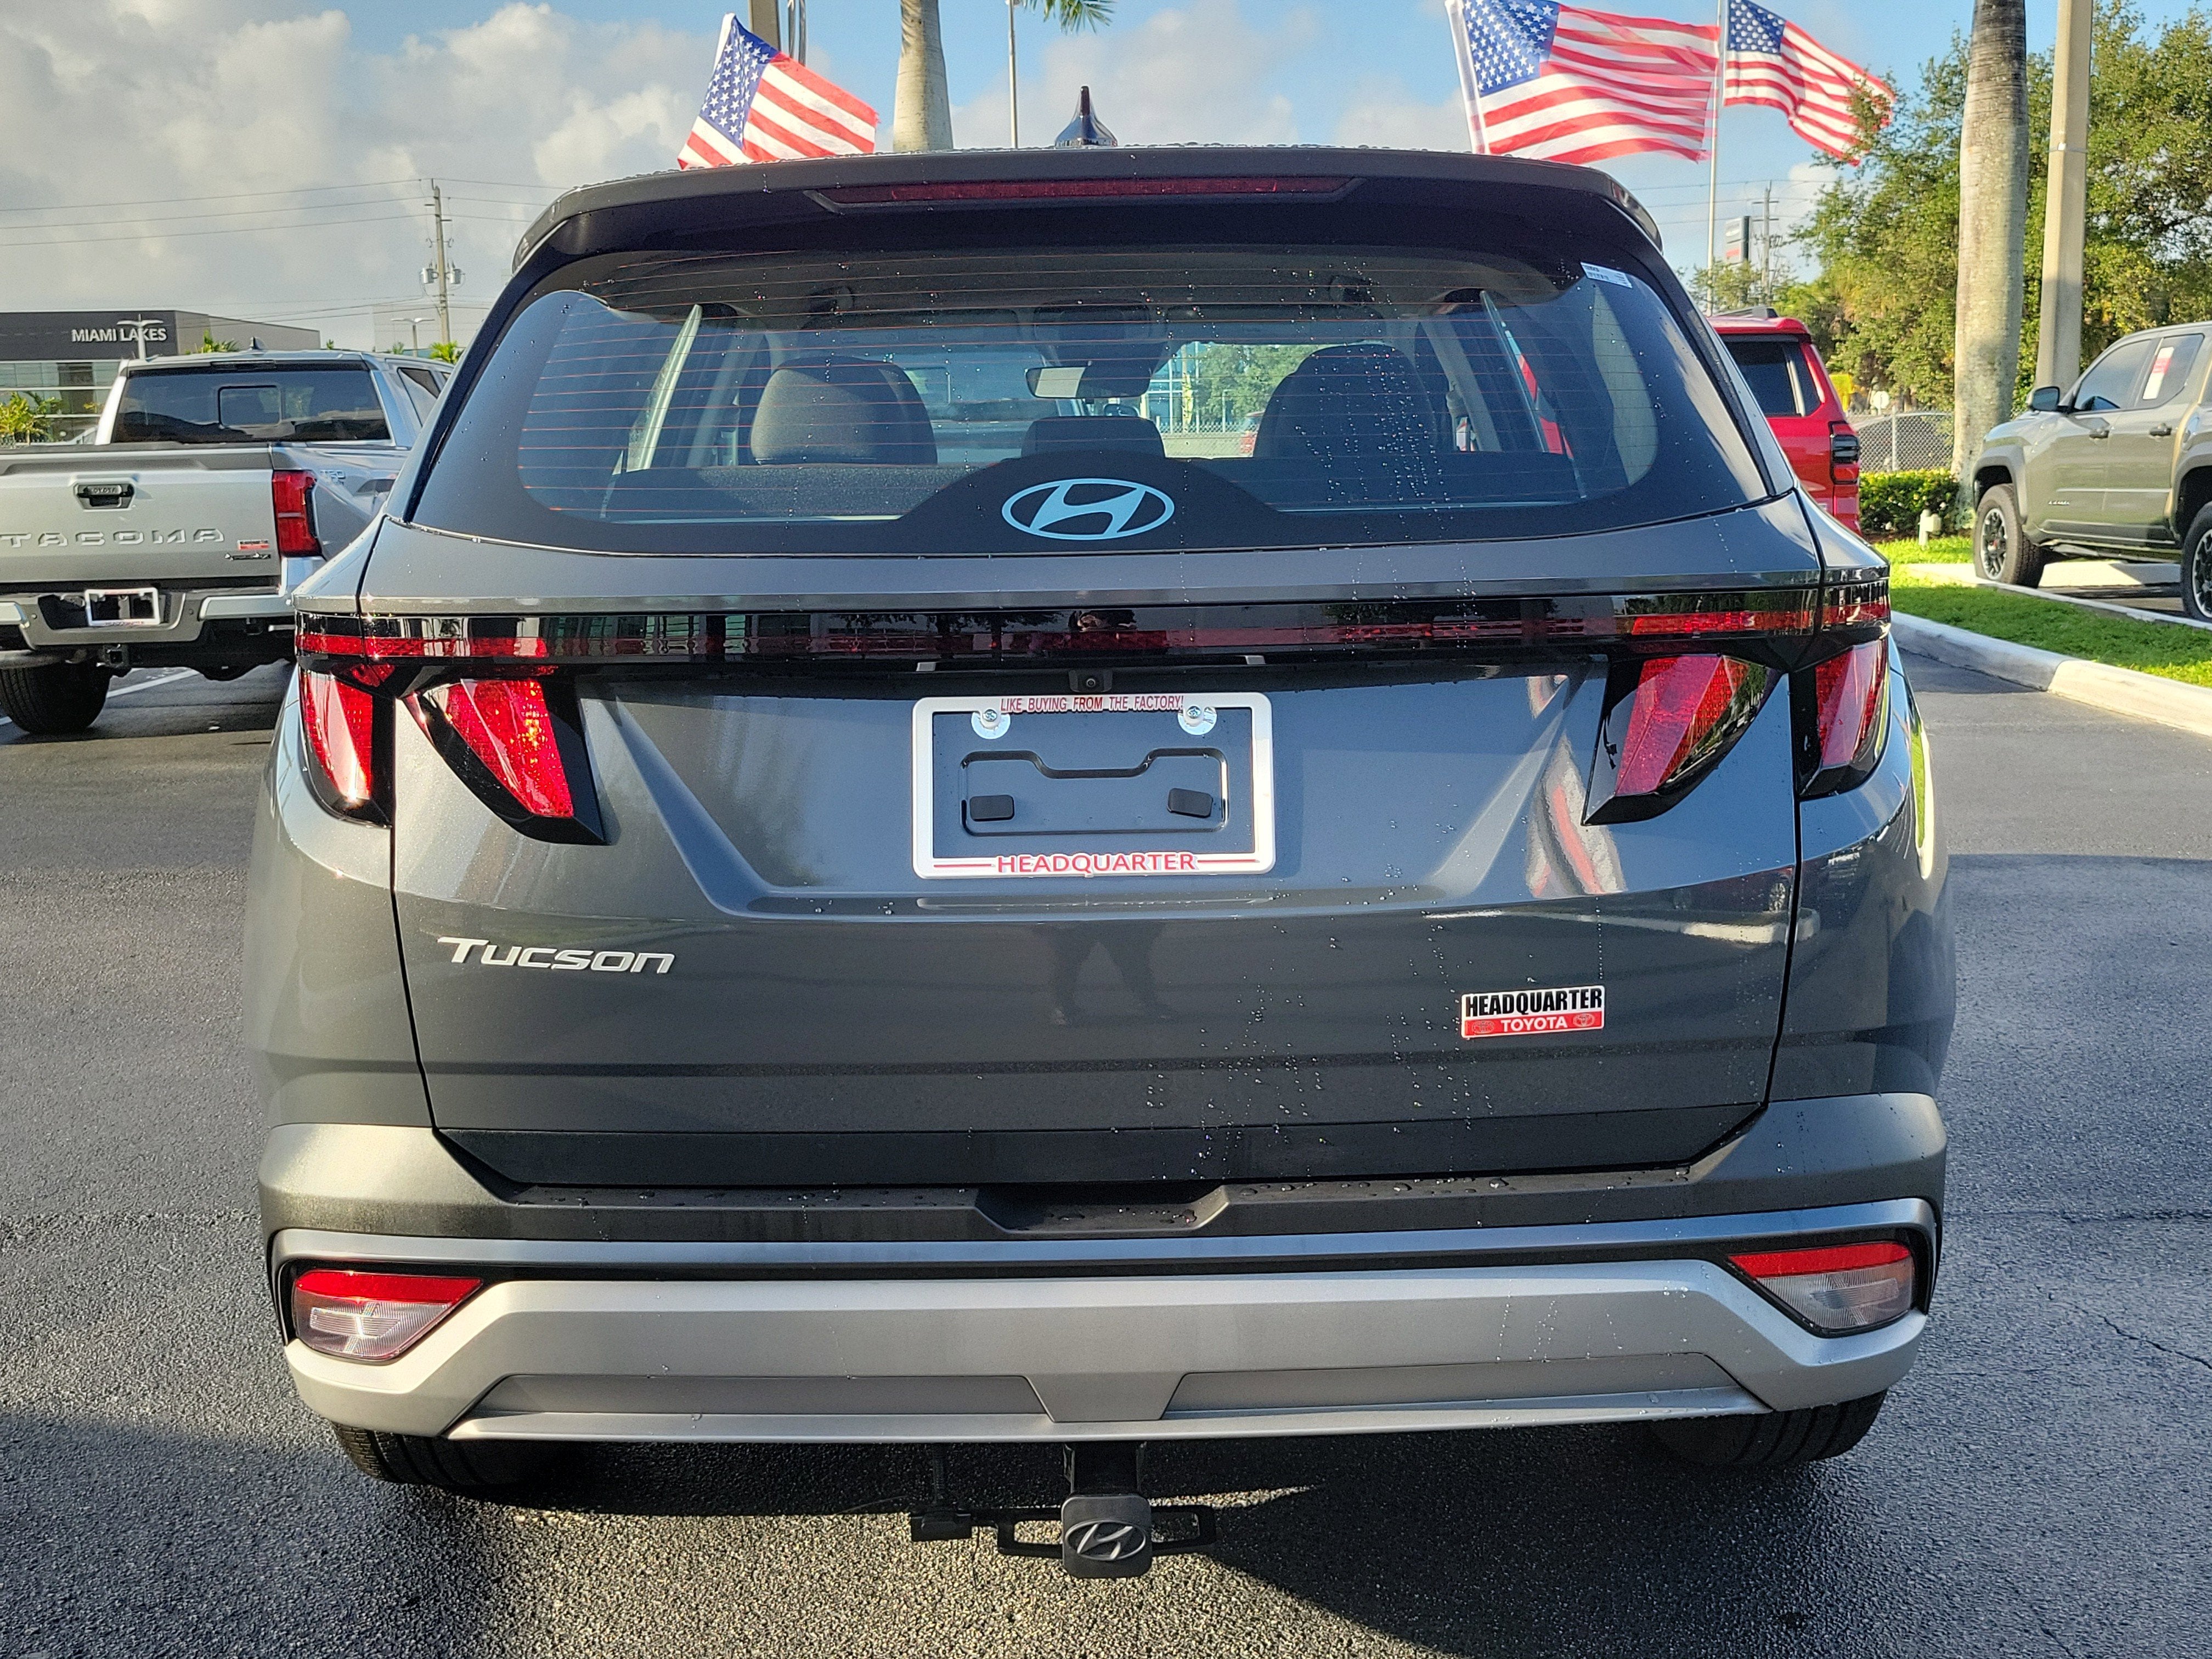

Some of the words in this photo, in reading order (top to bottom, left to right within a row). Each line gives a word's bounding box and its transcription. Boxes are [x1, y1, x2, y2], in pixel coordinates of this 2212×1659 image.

[71, 328, 117, 342] MIAMI
[120, 328, 167, 342] LAKES
[0, 528, 225, 548] TACOMA
[1001, 698, 1022, 711] LIKE
[1028, 697, 1066, 711] BUYING
[1073, 697, 1103, 709] FROM
[1109, 696, 1128, 709] THE
[1134, 695, 1184, 709] FACTORY!
[997, 854, 1195, 873] HEADQUARTER
[1465, 988, 1602, 1017] HEADQUARTER
[1500, 1016, 1568, 1032] TOYOTA
